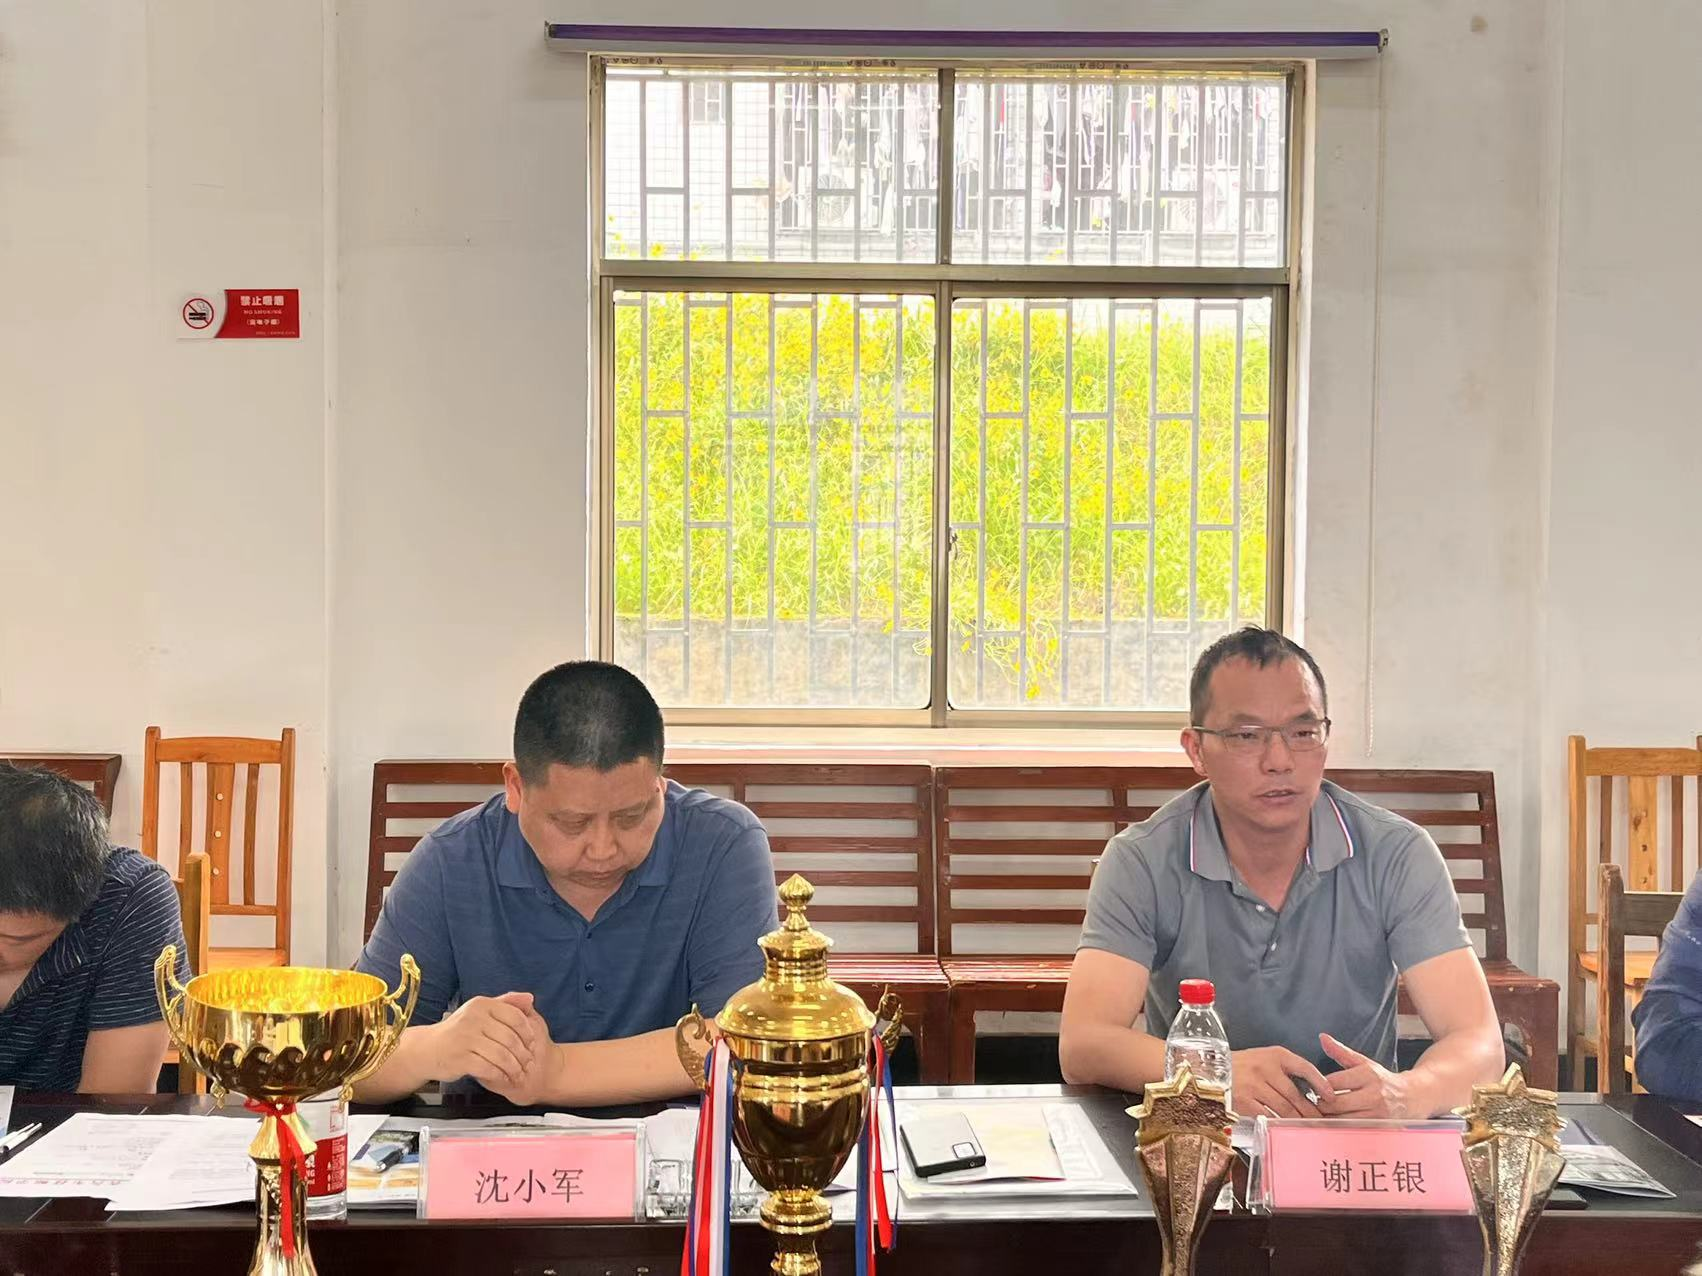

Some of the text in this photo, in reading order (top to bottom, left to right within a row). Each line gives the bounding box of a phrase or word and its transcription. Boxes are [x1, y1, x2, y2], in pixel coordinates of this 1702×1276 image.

[475, 1168, 584, 1204] 沈小军
[1319, 1158, 1427, 1194] 谢正银
